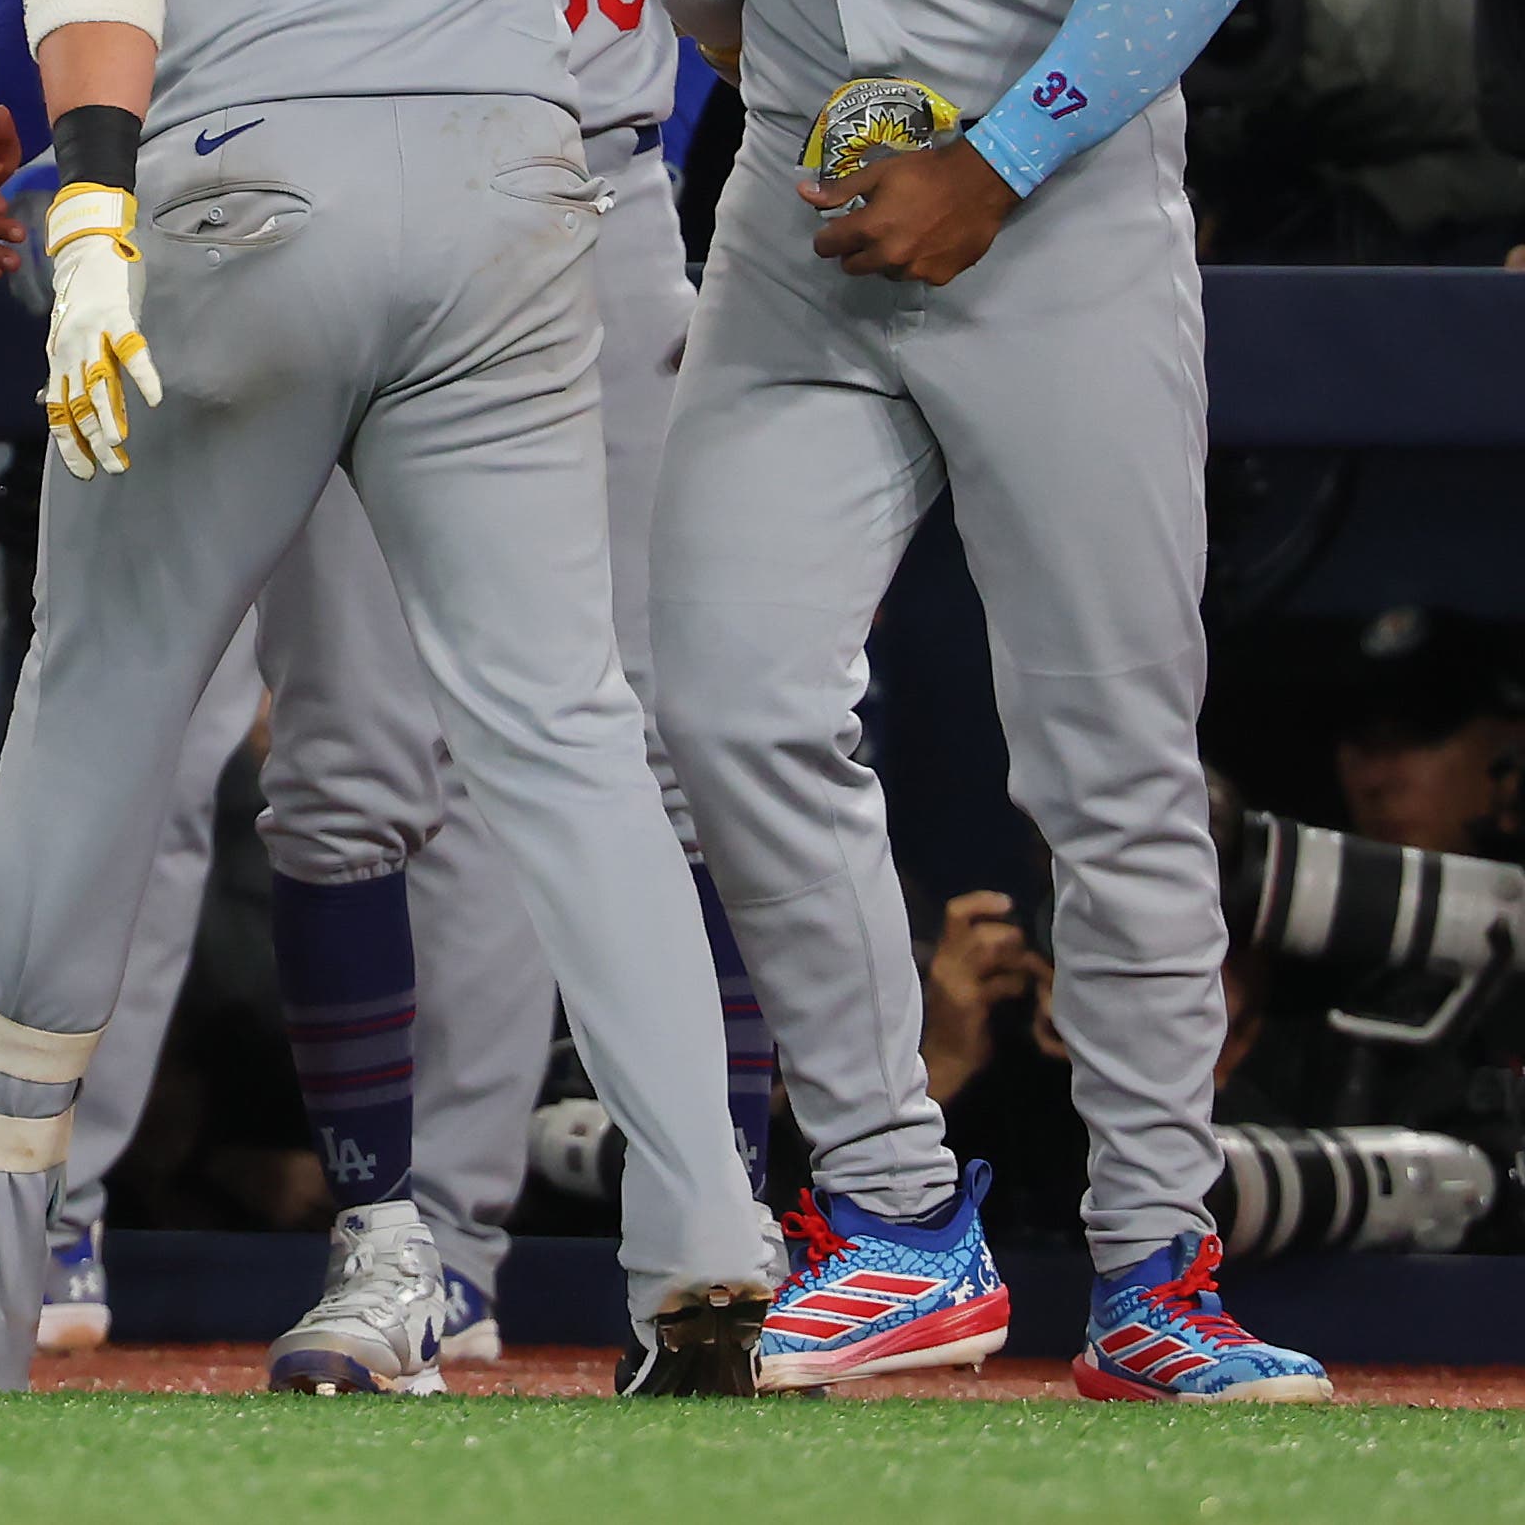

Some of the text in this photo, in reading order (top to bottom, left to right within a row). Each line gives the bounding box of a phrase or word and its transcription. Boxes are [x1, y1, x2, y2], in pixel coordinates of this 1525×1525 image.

[836, 97, 857, 113] Au
[859, 86, 906, 106] poivre
[1033, 71, 1088, 120] 37
[320, 1126, 377, 1182] LA
